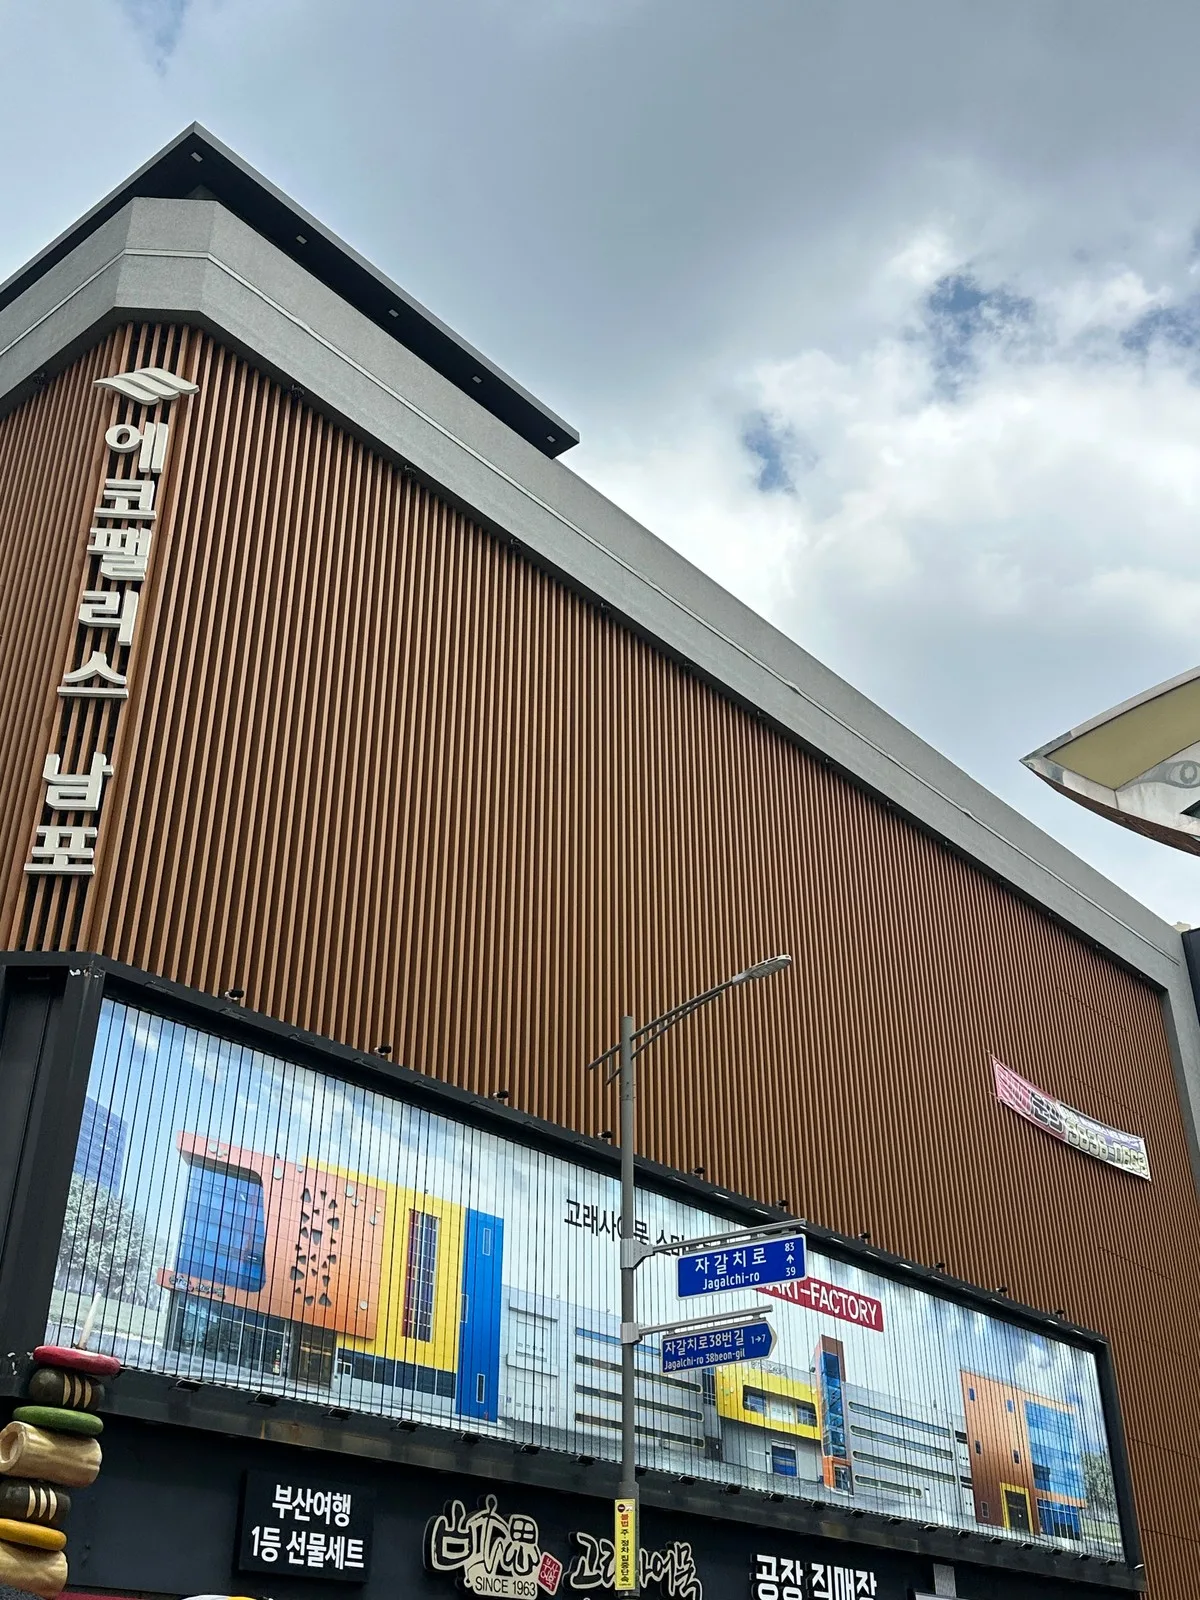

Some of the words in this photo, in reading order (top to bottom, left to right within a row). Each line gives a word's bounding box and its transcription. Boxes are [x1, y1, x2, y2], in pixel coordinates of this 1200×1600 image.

[57, 421, 169, 699] 에코팰리스
[24, 751, 114, 875] 남포
[564, 1198, 649, 1246] 고래사묵
[695, 1247, 767, 1275] 자갈치로
[784, 1242, 795, 1252] 83
[703, 1272, 760, 1290] Jagalchi-ro
[785, 1266, 796, 1277] 39
[665, 1329, 745, 1356] 자갈치로38번길
[664, 1357, 704, 1371] Jagalchi-ro
[705, 1348, 746, 1364] 38beon-gil
[272, 1484, 351, 1527] 부산여행
[251, 1526, 281, 1562] 1등
[286, 1531, 364, 1570] 선물세트
[475, 1576, 509, 1594] SINCE
[512, 1580, 536, 1597] 1963
[756, 1554, 803, 1600] 공장
